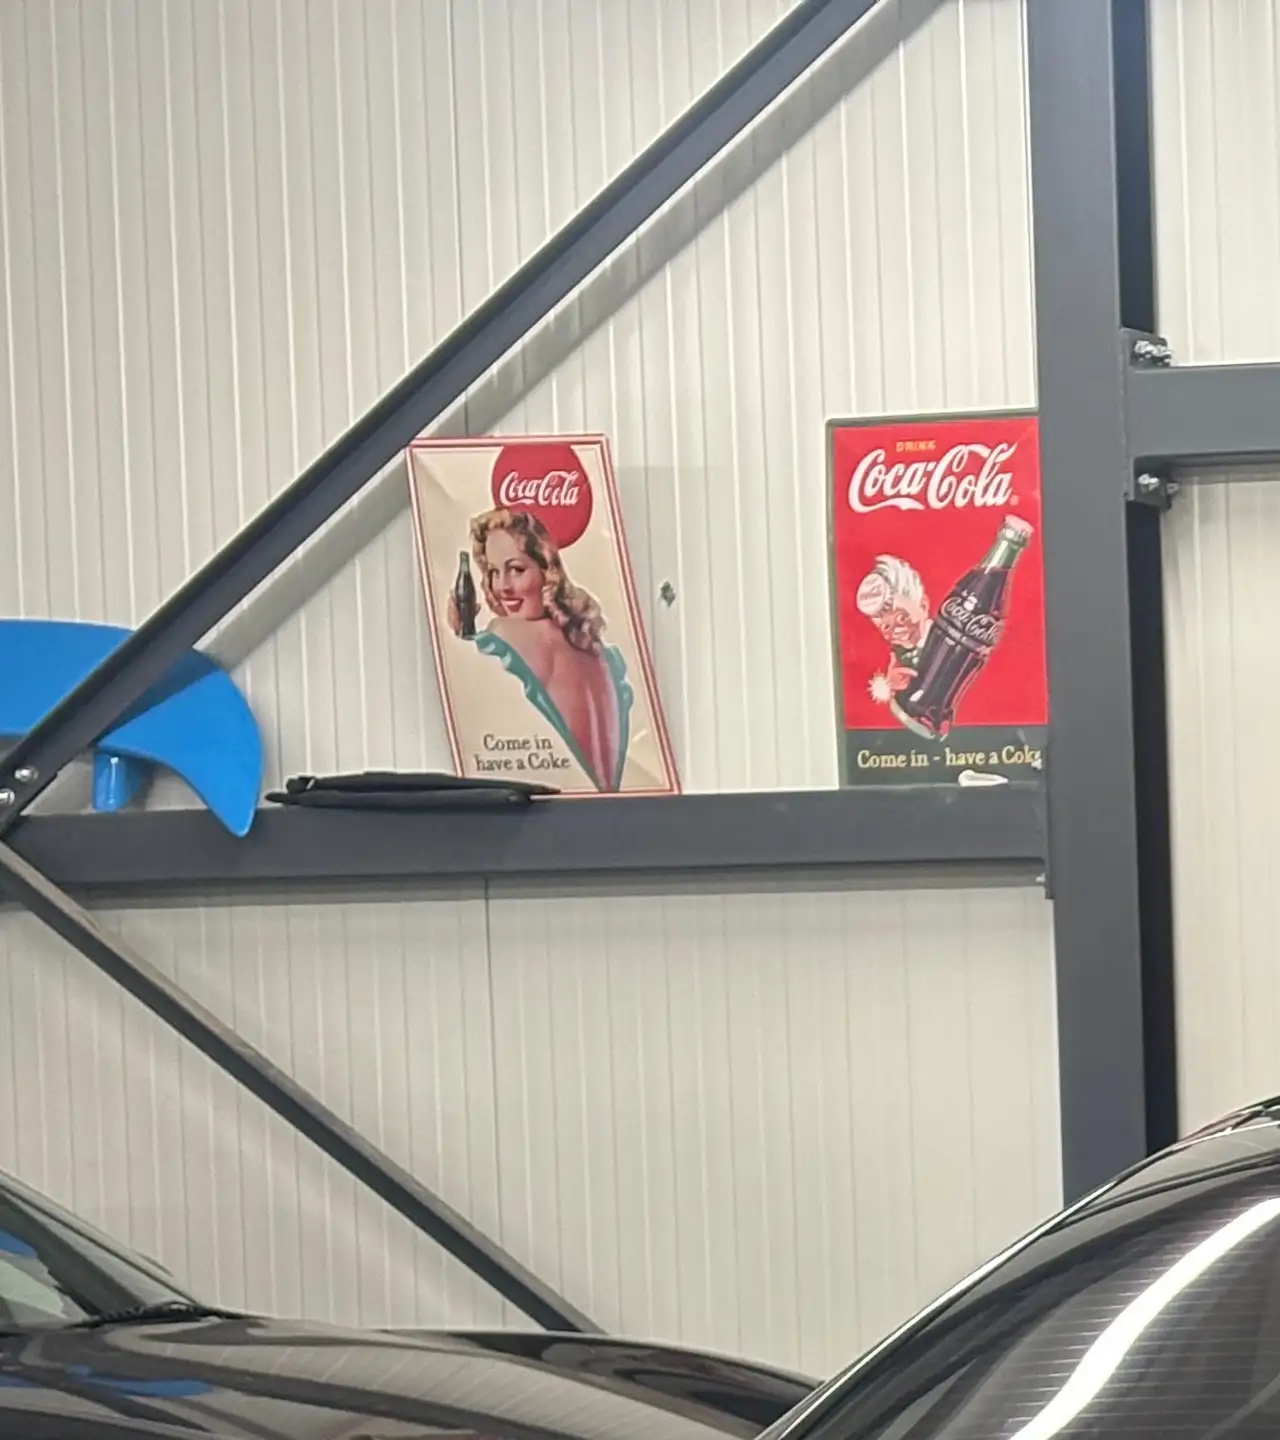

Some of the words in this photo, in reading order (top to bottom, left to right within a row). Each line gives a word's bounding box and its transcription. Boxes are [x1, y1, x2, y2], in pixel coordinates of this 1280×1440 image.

[896, 440, 936, 452] DRINK
[848, 443, 1018, 513] Coca-Cola
[500, 470, 579, 505] Coca-Cola
[484, 734, 531, 750] Come
[535, 733, 553, 749] in
[475, 756, 511, 772] have
[515, 760, 525, 770] a
[528, 755, 570, 769] Coke
[857, 750, 907, 768] Come
[911, 749, 928, 766] in
[945, 748, 985, 766] have
[989, 752, 998, 764] a
